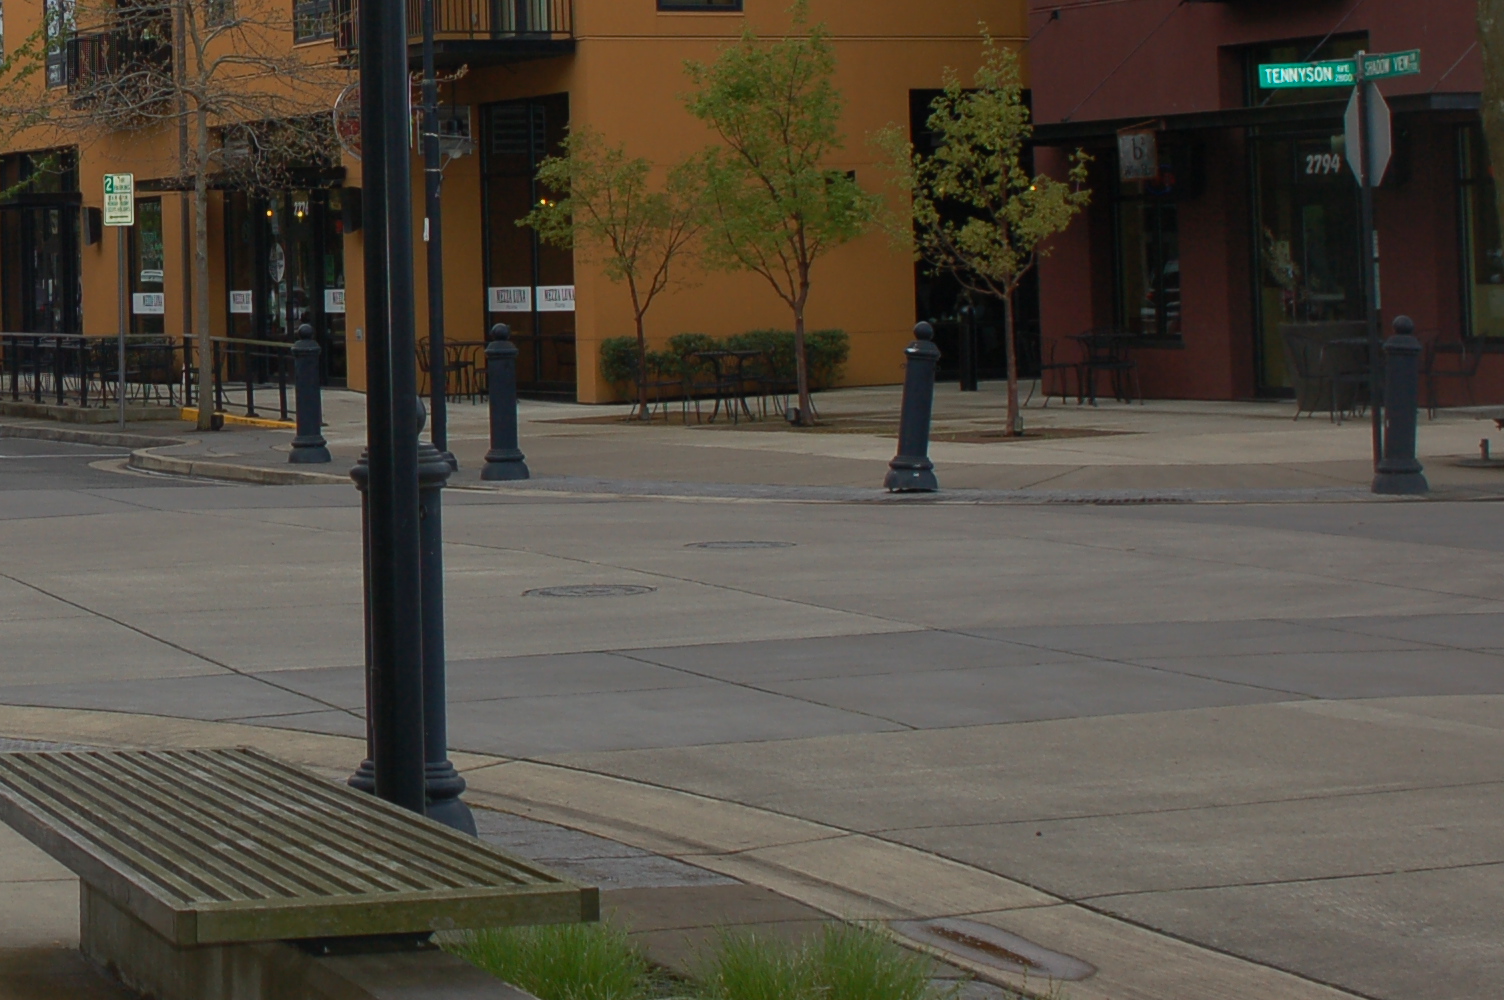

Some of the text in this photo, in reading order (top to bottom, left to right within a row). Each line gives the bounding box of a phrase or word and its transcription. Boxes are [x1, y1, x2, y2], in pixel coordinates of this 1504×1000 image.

[1265, 64, 1350, 84] TENNYSON AVE
[1364, 58, 1390, 76] SHADOW
[1335, 73, 1353, 83] 2800
[1306, 153, 1340, 174] 2794
[105, 177, 113, 192] 2
